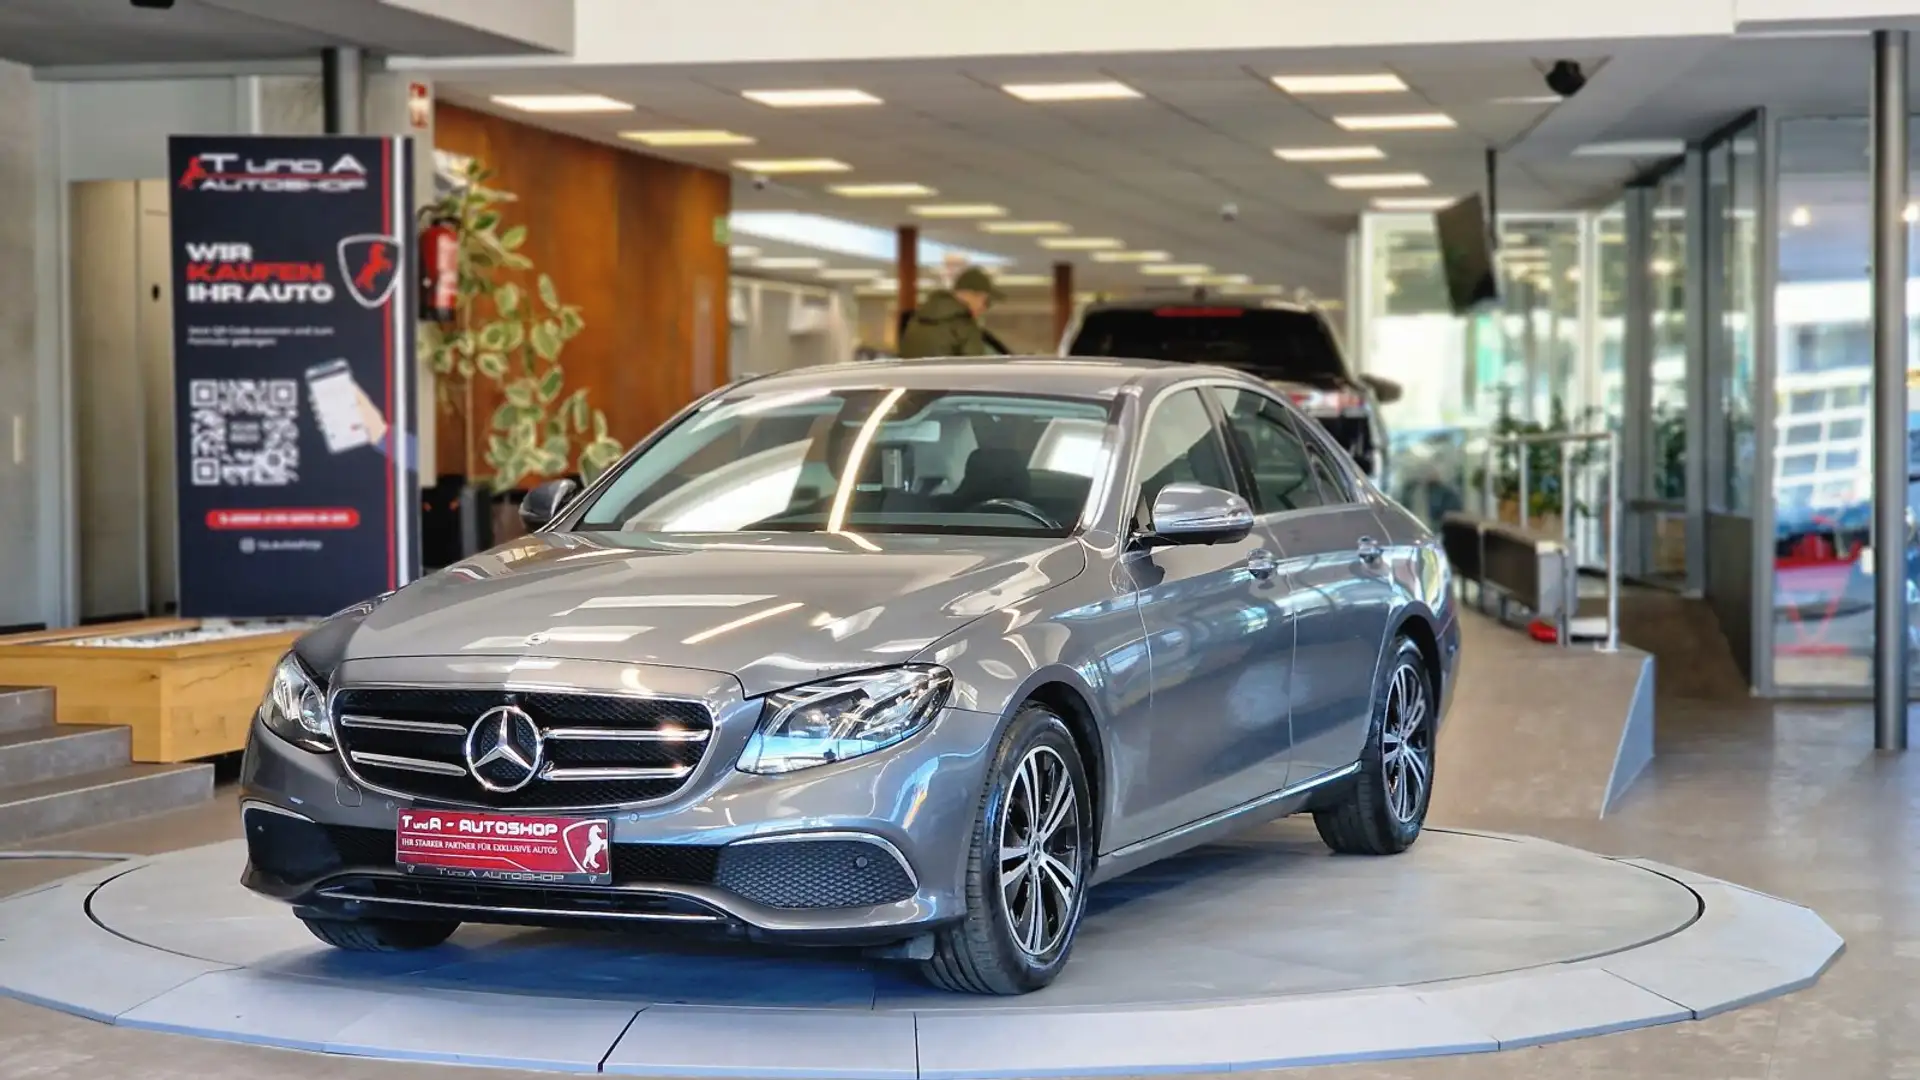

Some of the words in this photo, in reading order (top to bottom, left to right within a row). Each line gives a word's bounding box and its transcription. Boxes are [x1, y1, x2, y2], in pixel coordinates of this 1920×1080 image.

[200, 153, 238, 172] T
[329, 153, 368, 174] A
[200, 178, 368, 192] AUTOSHOP
[185, 242, 253, 262] WIR
[186, 262, 325, 281] KAUFEN
[187, 283, 245, 302] IHR
[247, 283, 334, 303] AUTO
[402, 815, 414, 829] T
[429, 817, 442, 831] A
[459, 819, 558, 837] AUTOSHOP
[401, 838, 414, 846] IHR
[415, 838, 444, 848] STARKER
[445, 841, 476, 850] PARTNER
[477, 842, 491, 851] FÜR
[493, 843, 532, 853] EXKLUSIVE
[532, 845, 558, 854] AUTOS
[482, 871, 564, 882] AUTOSHOP
